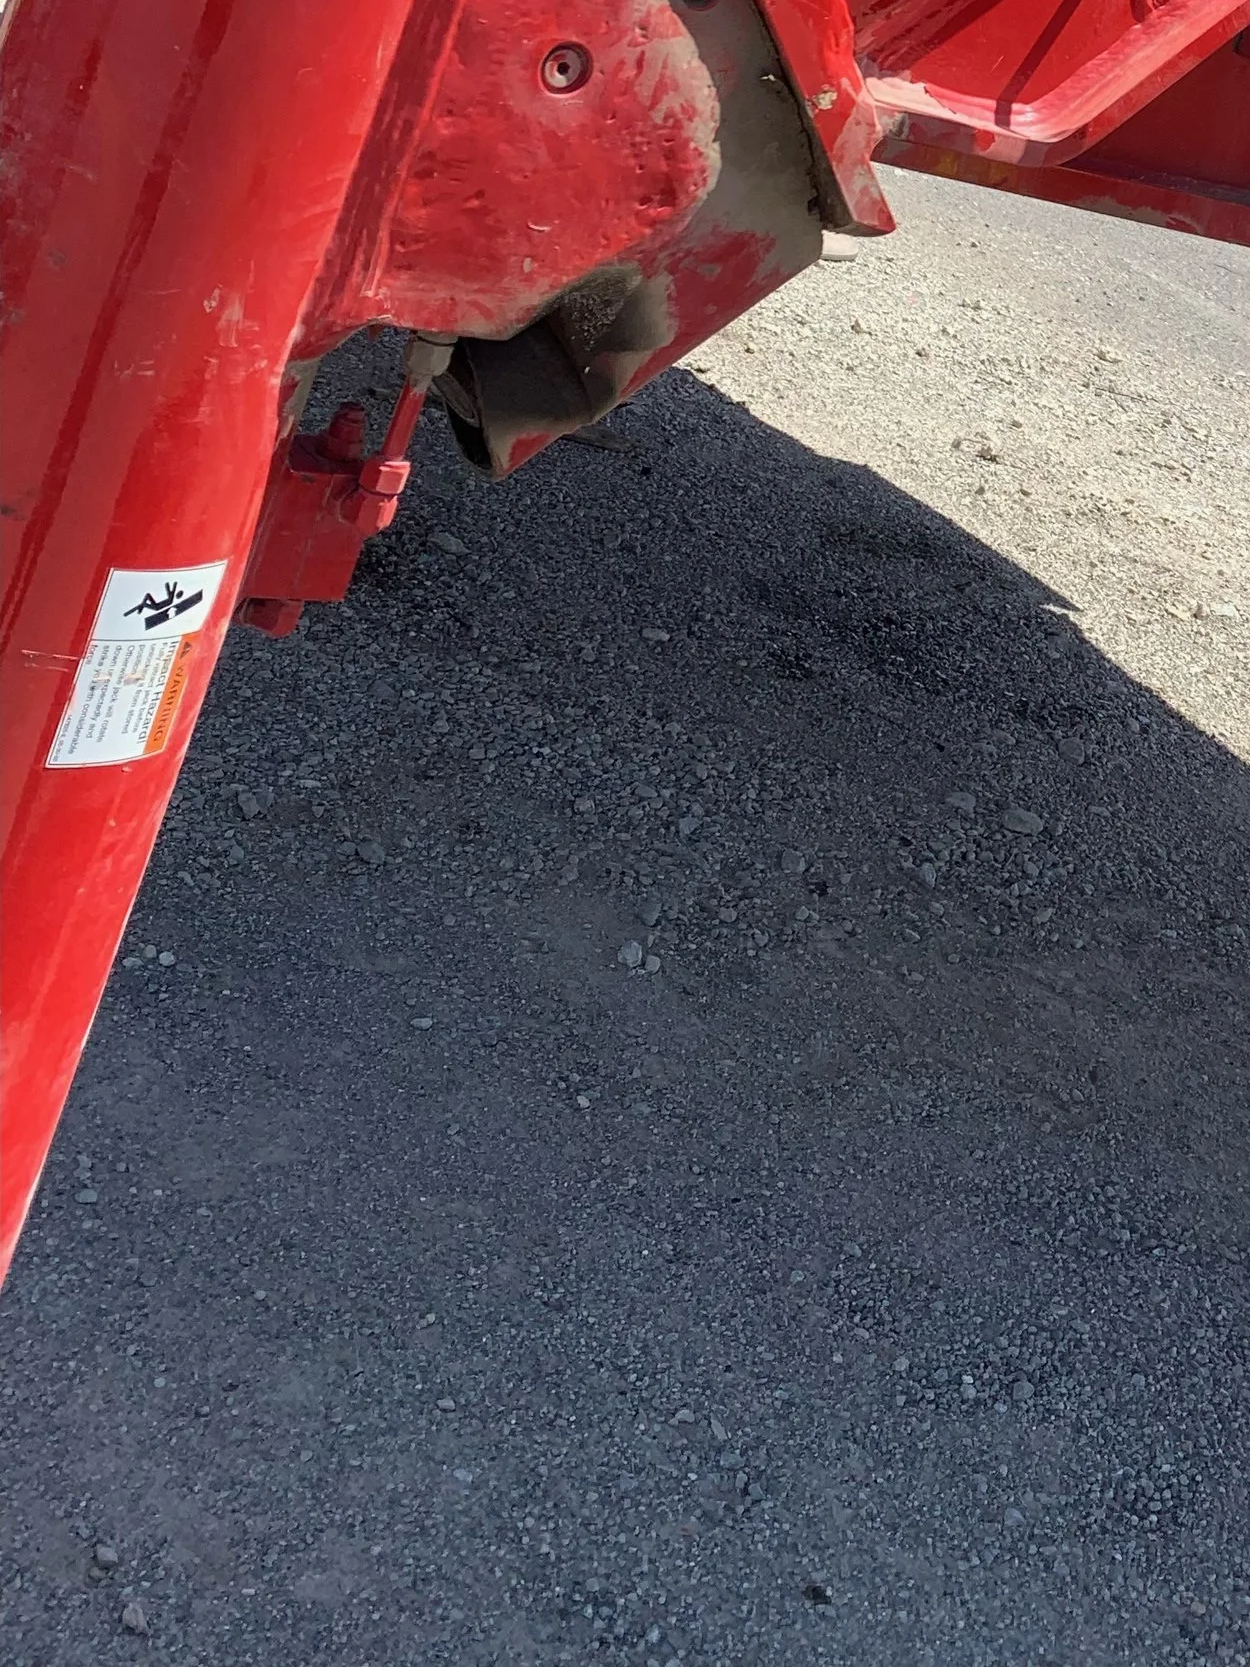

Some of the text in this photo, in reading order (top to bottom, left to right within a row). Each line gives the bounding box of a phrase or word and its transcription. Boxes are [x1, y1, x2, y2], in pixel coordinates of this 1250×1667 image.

[110, 687, 121, 703] jack
[137, 641, 178, 744] Impact Hazard!
[153, 665, 184, 741] WARNING
